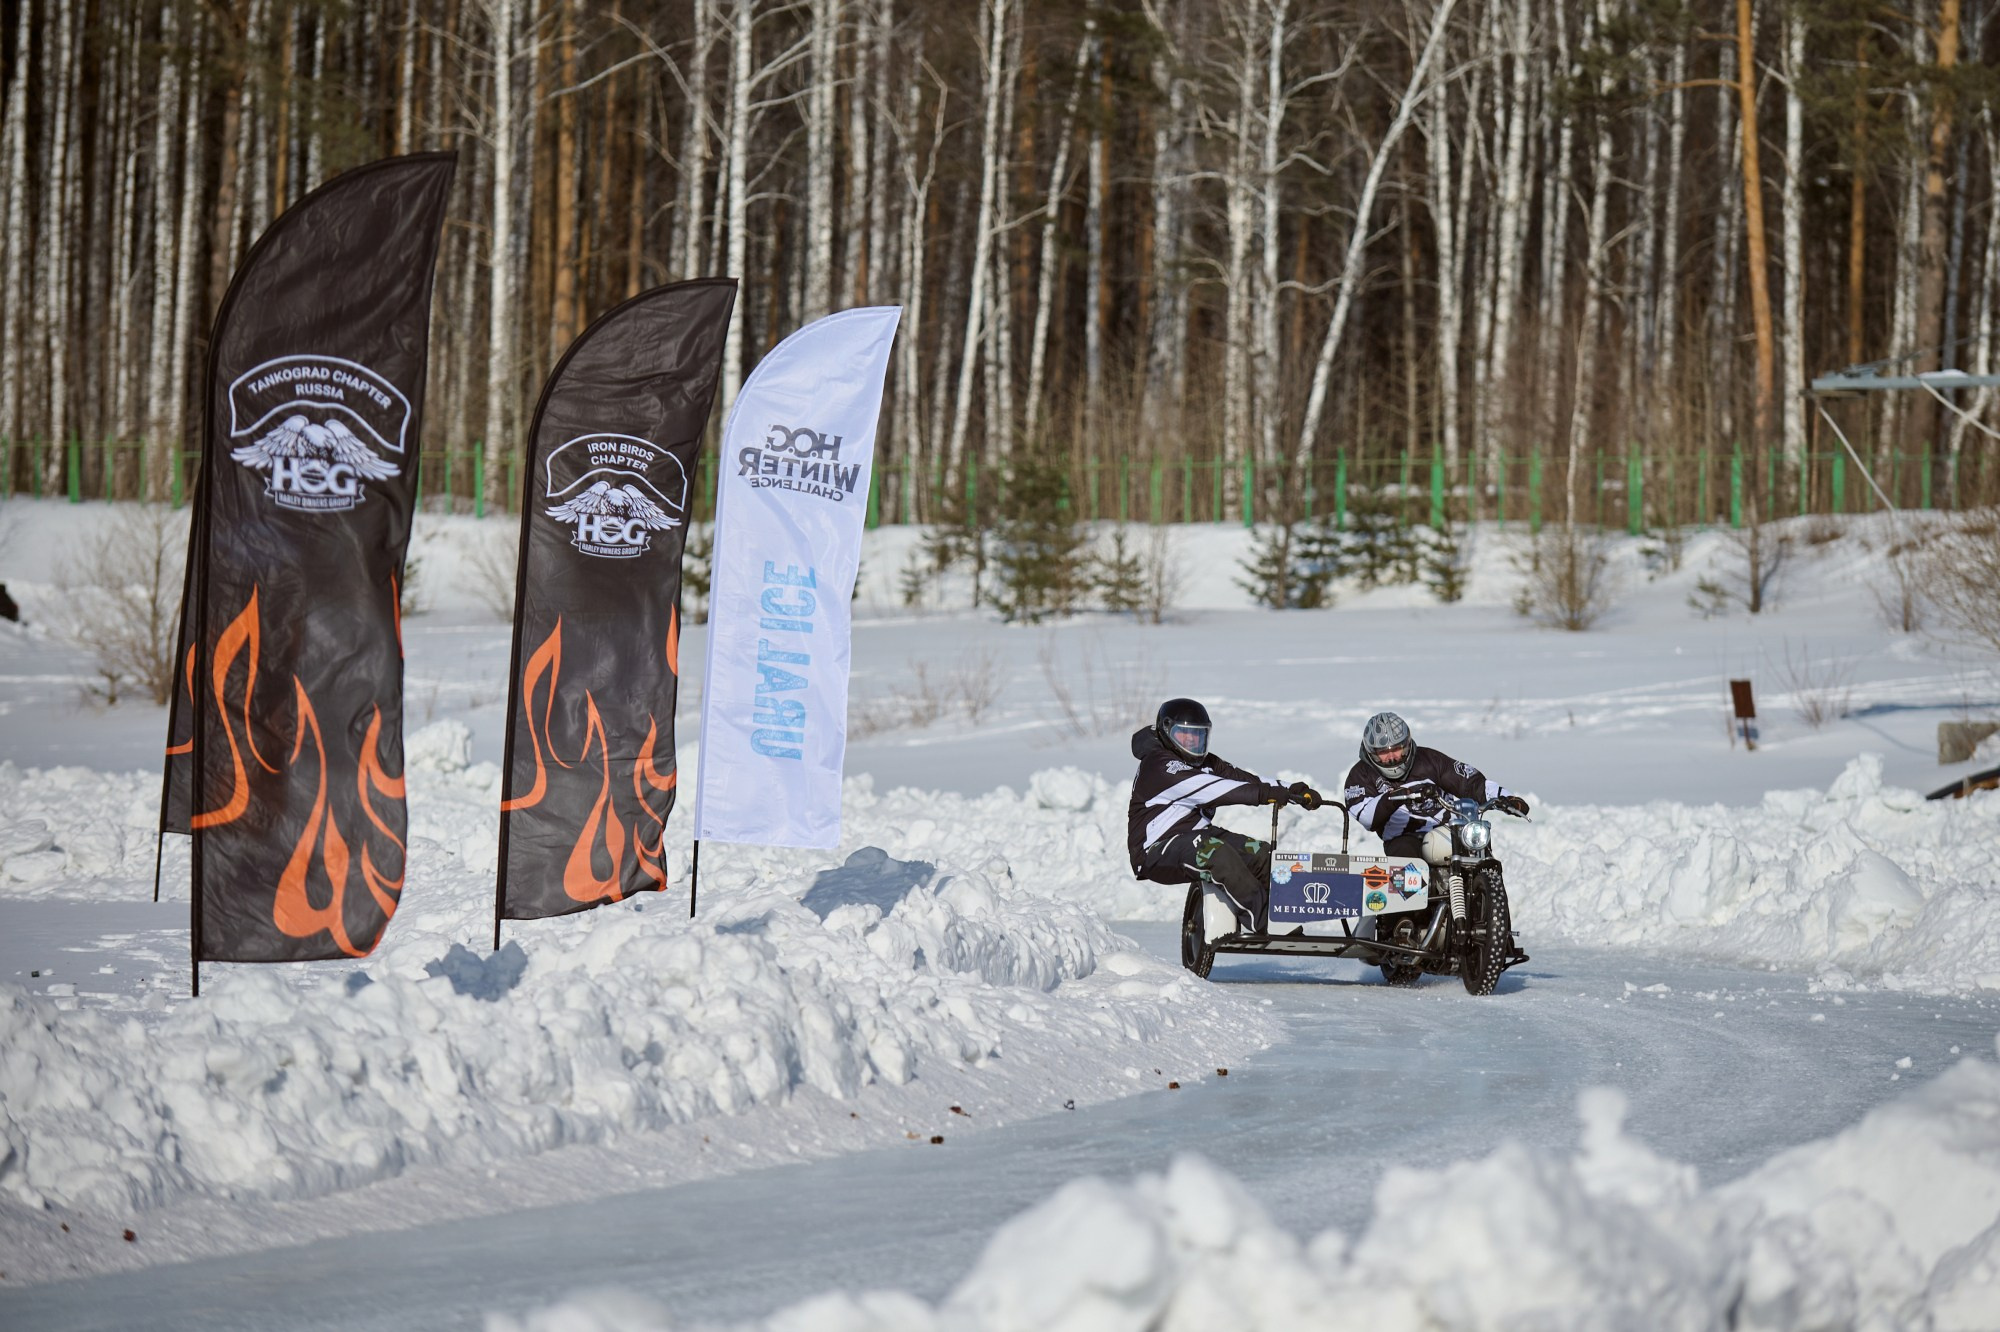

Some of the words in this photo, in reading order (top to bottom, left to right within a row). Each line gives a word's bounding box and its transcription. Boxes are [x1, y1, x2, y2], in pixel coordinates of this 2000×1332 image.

[248, 366, 330, 395] TANKOGRAD
[332, 371, 392, 410] CHAPTER
[295, 383, 344, 401] RUSSIA
[587, 441, 618, 454] IRON
[620, 443, 655, 462] BIRDS
[590, 454, 649, 472] CHAPTER
[581, 543, 600, 553] HARLEY
[599, 546, 621, 555] OWNERS
[621, 546, 639, 555] GROUP
[1407, 876, 1418, 885] 66
[1273, 905, 1359, 916] МЕТКОМБАНК
